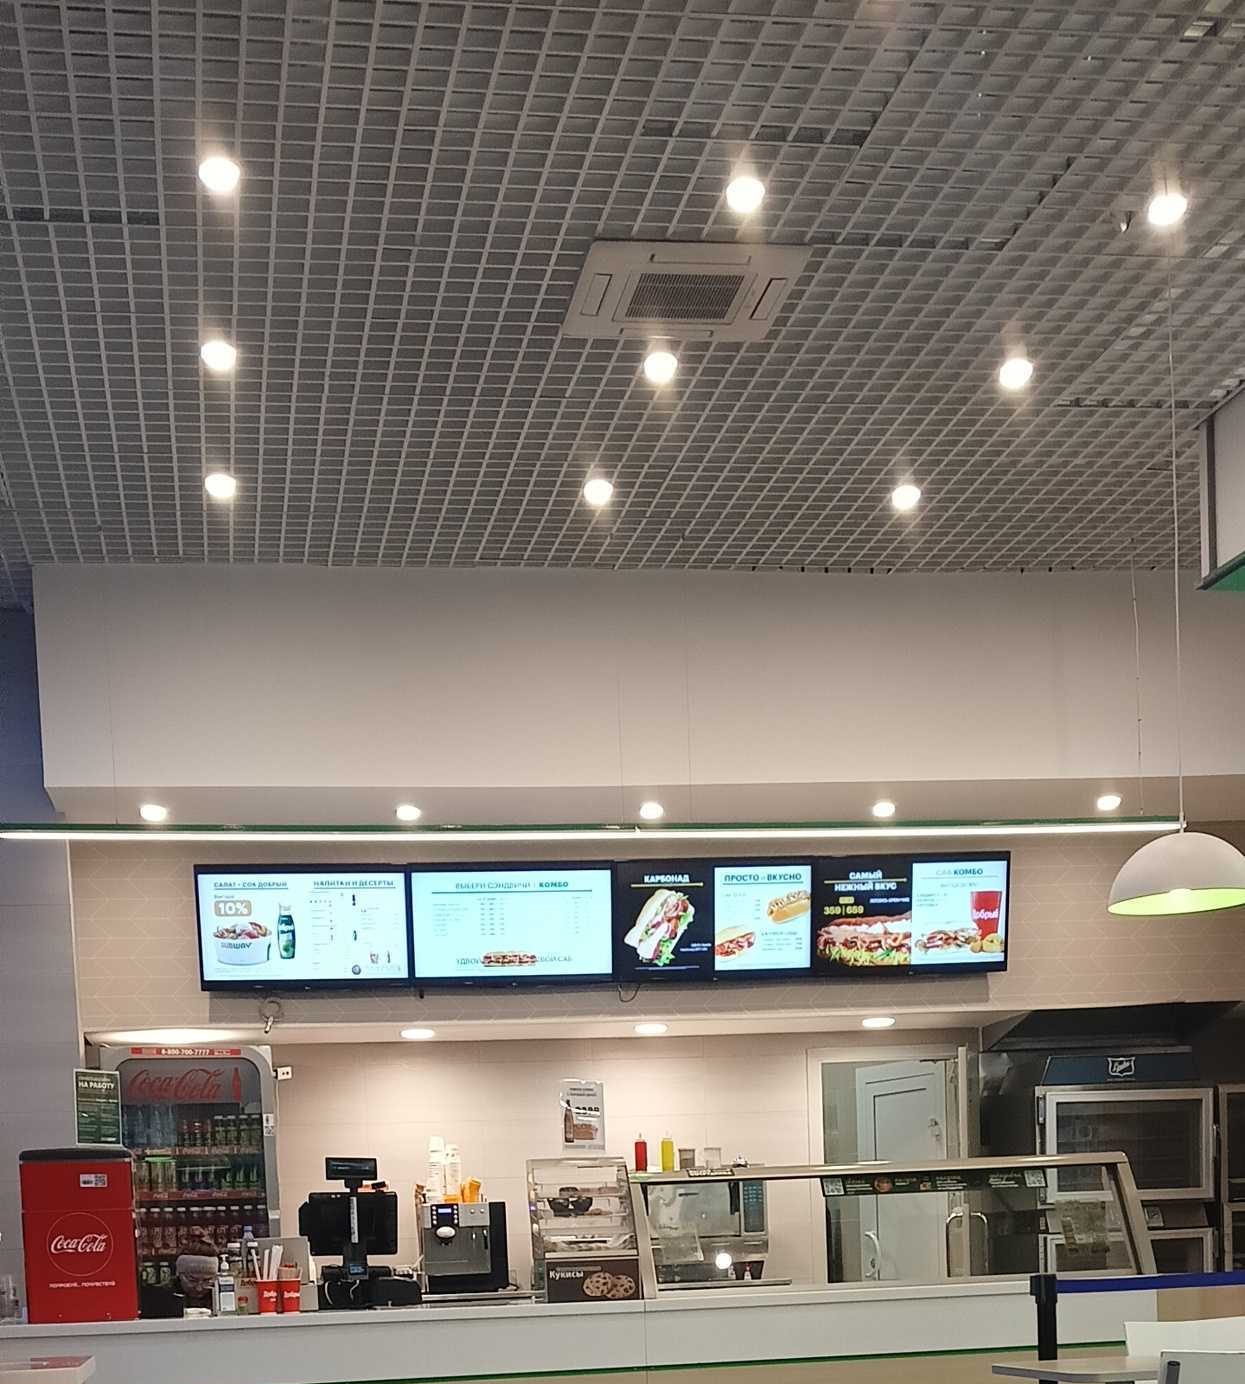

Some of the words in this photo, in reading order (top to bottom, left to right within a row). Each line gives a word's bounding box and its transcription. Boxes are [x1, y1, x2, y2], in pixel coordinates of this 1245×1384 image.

[849, 869, 883, 880] САМЫЙ
[953, 868, 984, 876] КОМБО
[643, 873, 691, 884] КАРБОНАД
[724, 874, 760, 883] ПРОСТО
[767, 873, 803, 882] ВКУСНО
[834, 881, 874, 892] НЕЖНЫЙ
[875, 881, 897, 891] ВКУС
[218, 902, 248, 915] 10%
[128, 1068, 225, 1100] Coca-Cola
[51, 1234, 108, 1254] Coca-Cola
[549, 1270, 584, 1280] Кукисы
